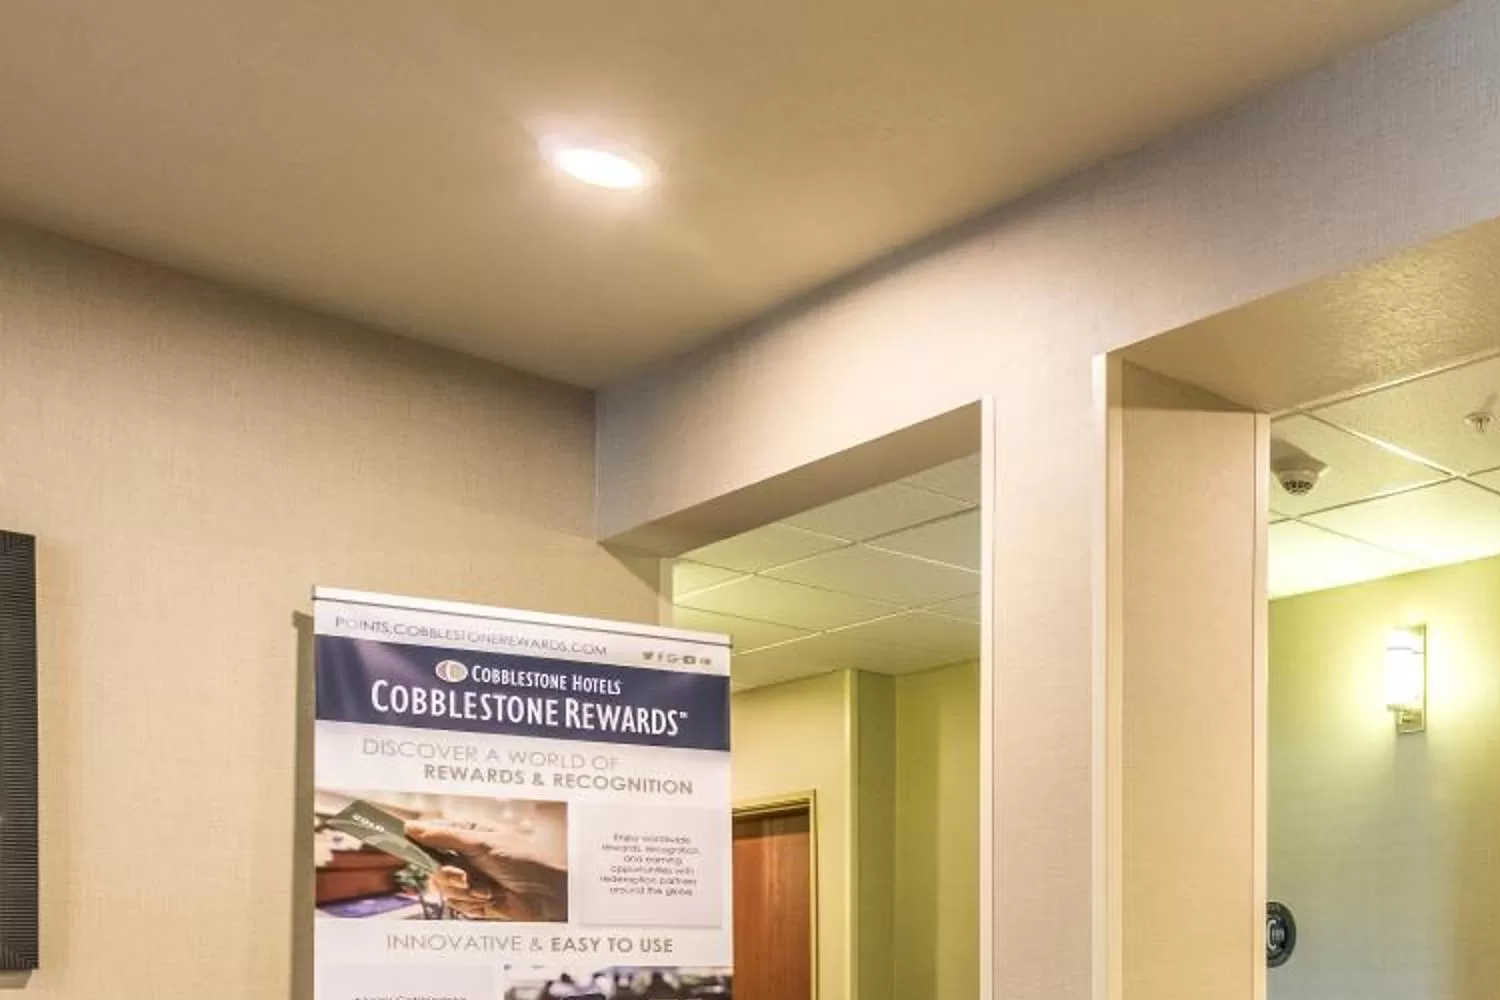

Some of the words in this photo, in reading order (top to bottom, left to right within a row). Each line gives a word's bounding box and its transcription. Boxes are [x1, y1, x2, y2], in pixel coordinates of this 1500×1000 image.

[471, 665, 567, 691] COBBLESTONE
[571, 674, 621, 695] HOTELS
[371, 679, 559, 727] COBBLESTONE
[363, 736, 475, 762] DISCOVER
[485, 748, 499, 763] A
[509, 749, 585, 769] WORLD
[591, 755, 620, 771] OF
[423, 764, 525, 785] REWARDS
[531, 773, 545, 787] &
[552, 773, 694, 795] RECOGNITION
[386, 934, 522, 952] INNOVATIVE
[529, 937, 543, 951] &
[550, 936, 601, 952] EASY
[606, 937, 633, 952] TO
[640, 937, 673, 953] USE
